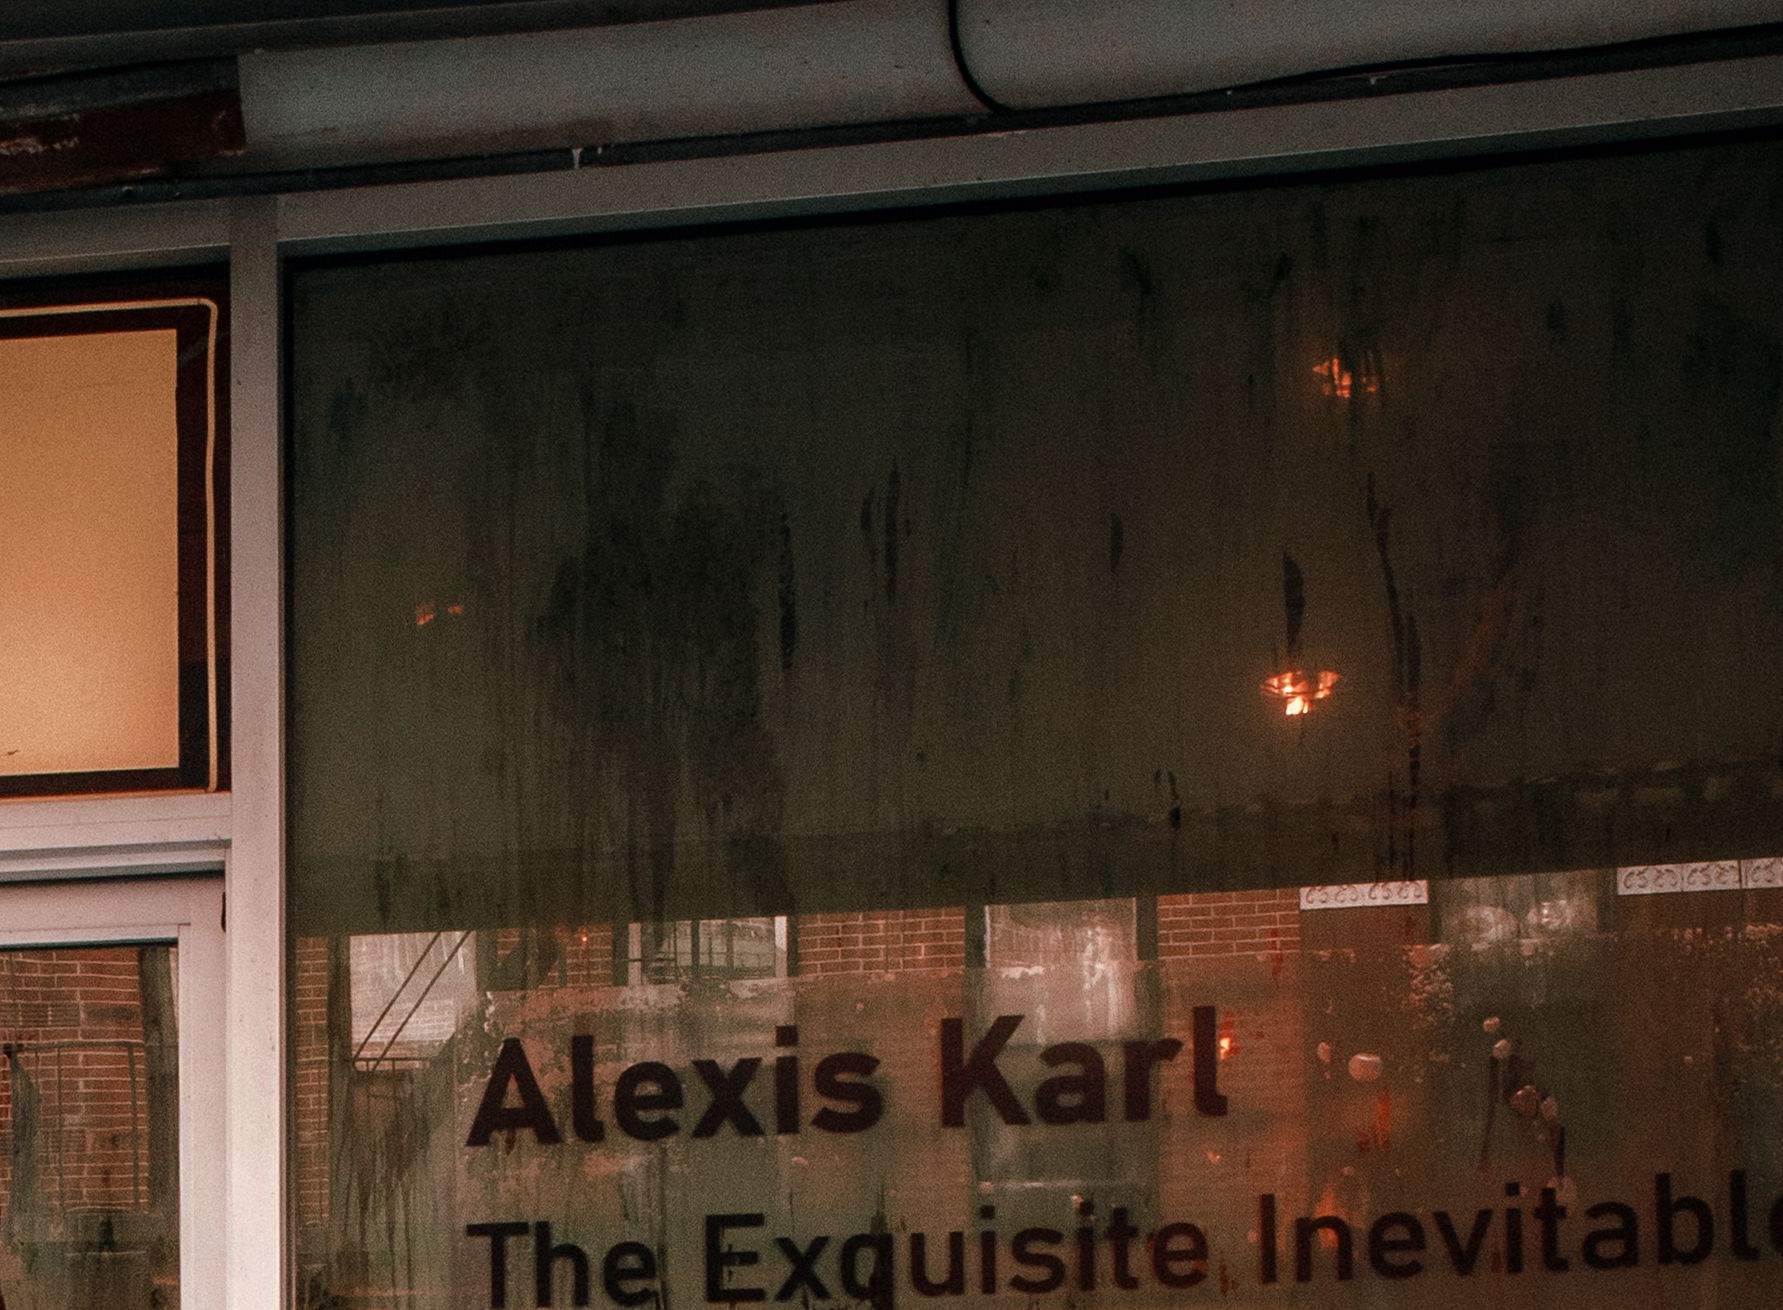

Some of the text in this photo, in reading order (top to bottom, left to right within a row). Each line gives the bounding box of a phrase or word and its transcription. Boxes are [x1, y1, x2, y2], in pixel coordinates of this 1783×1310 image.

[465, 1006, 1229, 1147] Alexis Karl
[465, 1221, 657, 1310] The
[1259, 1169, 1783, 1285] Inevitabl
